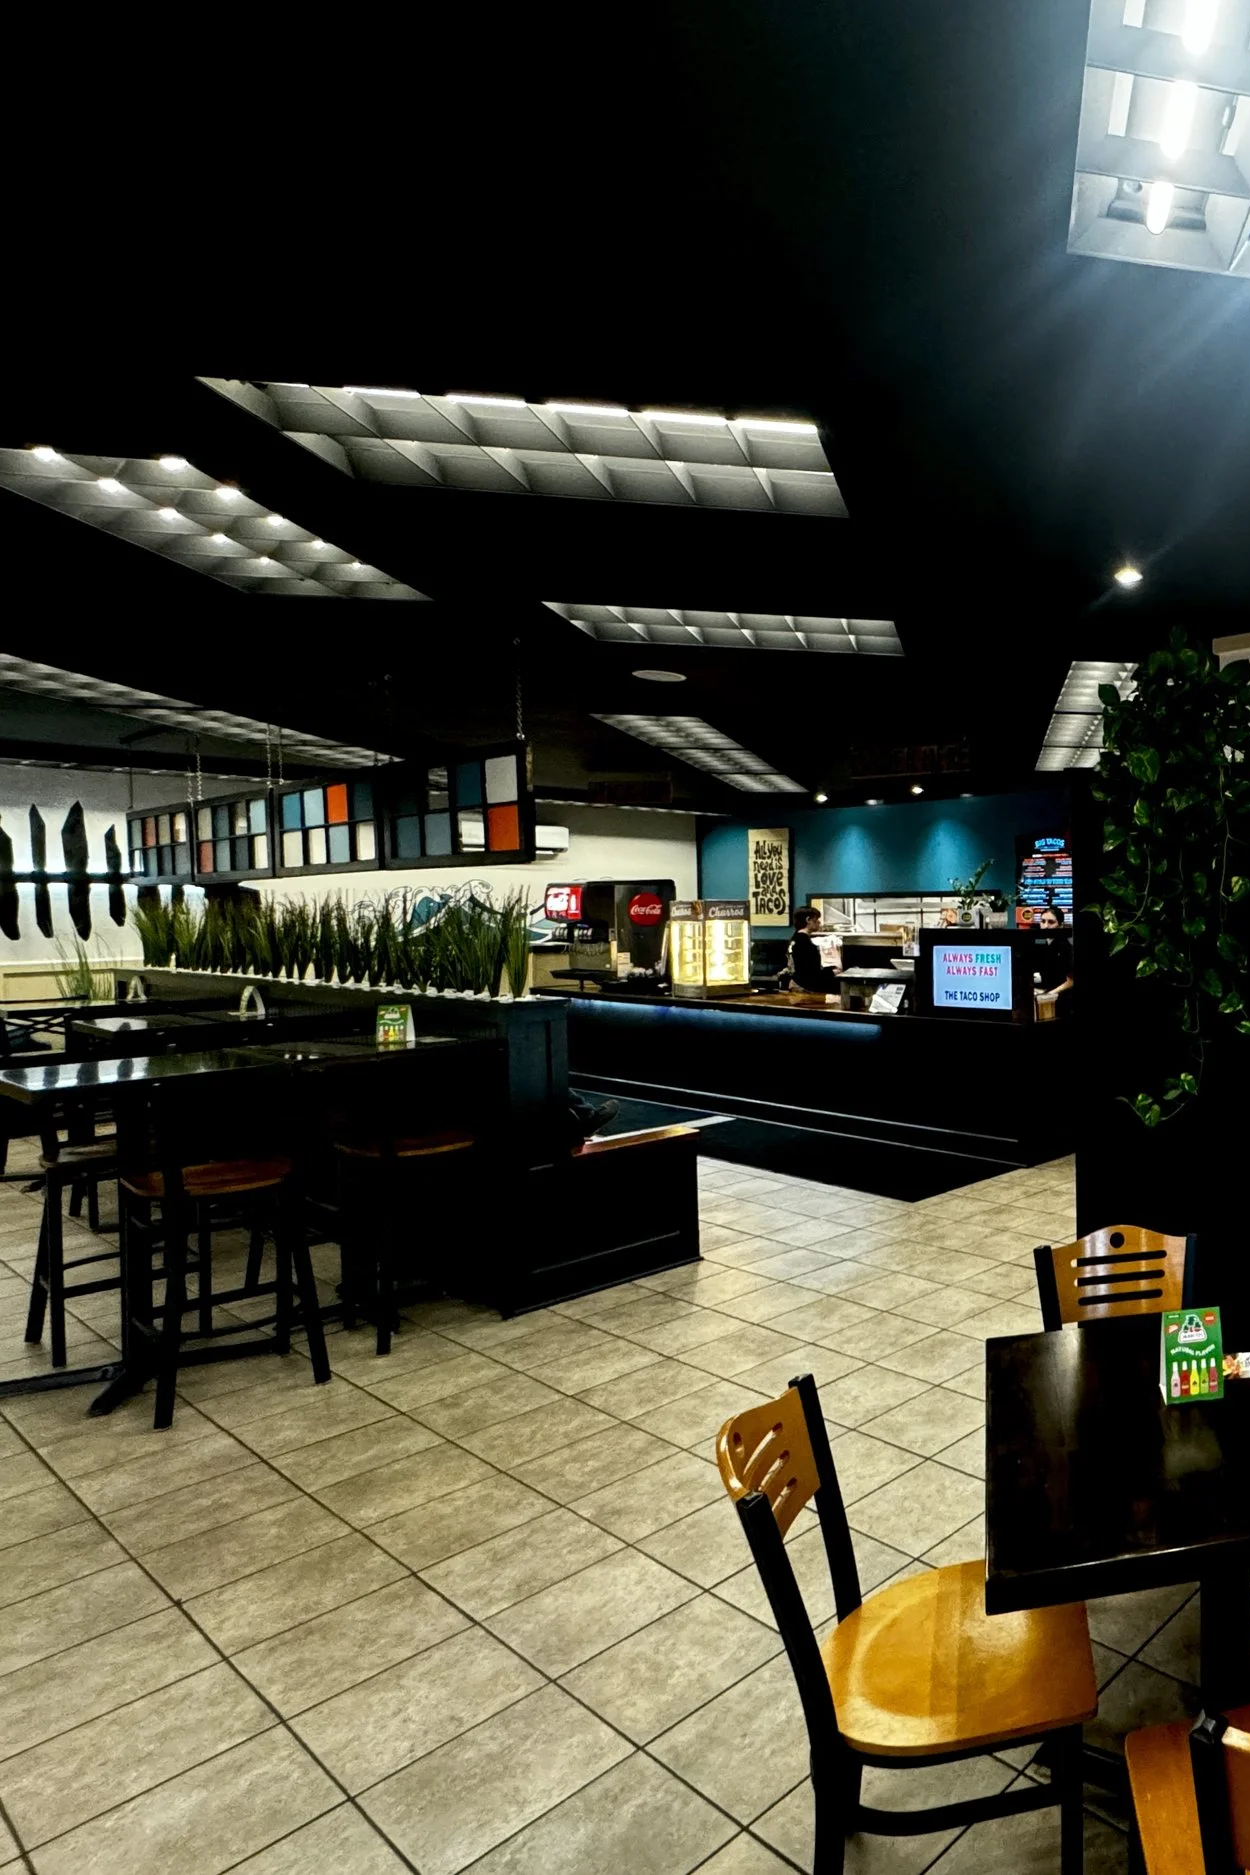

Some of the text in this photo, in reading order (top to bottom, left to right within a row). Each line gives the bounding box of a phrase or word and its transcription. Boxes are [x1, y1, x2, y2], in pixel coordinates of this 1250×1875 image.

[753, 856, 783, 873] need is
[752, 888, 786, 915] TACOS
[630, 904, 662, 916] Coca-Cola
[708, 906, 745, 918] Churros
[943, 953, 1001, 964] ALWAYS FRESH
[946, 966, 998, 976] ALWAYS FAST
[944, 990, 1000, 1003] THE TACO SHOP
[1171, 1344, 1215, 1356] NATURAL FLAVOR
